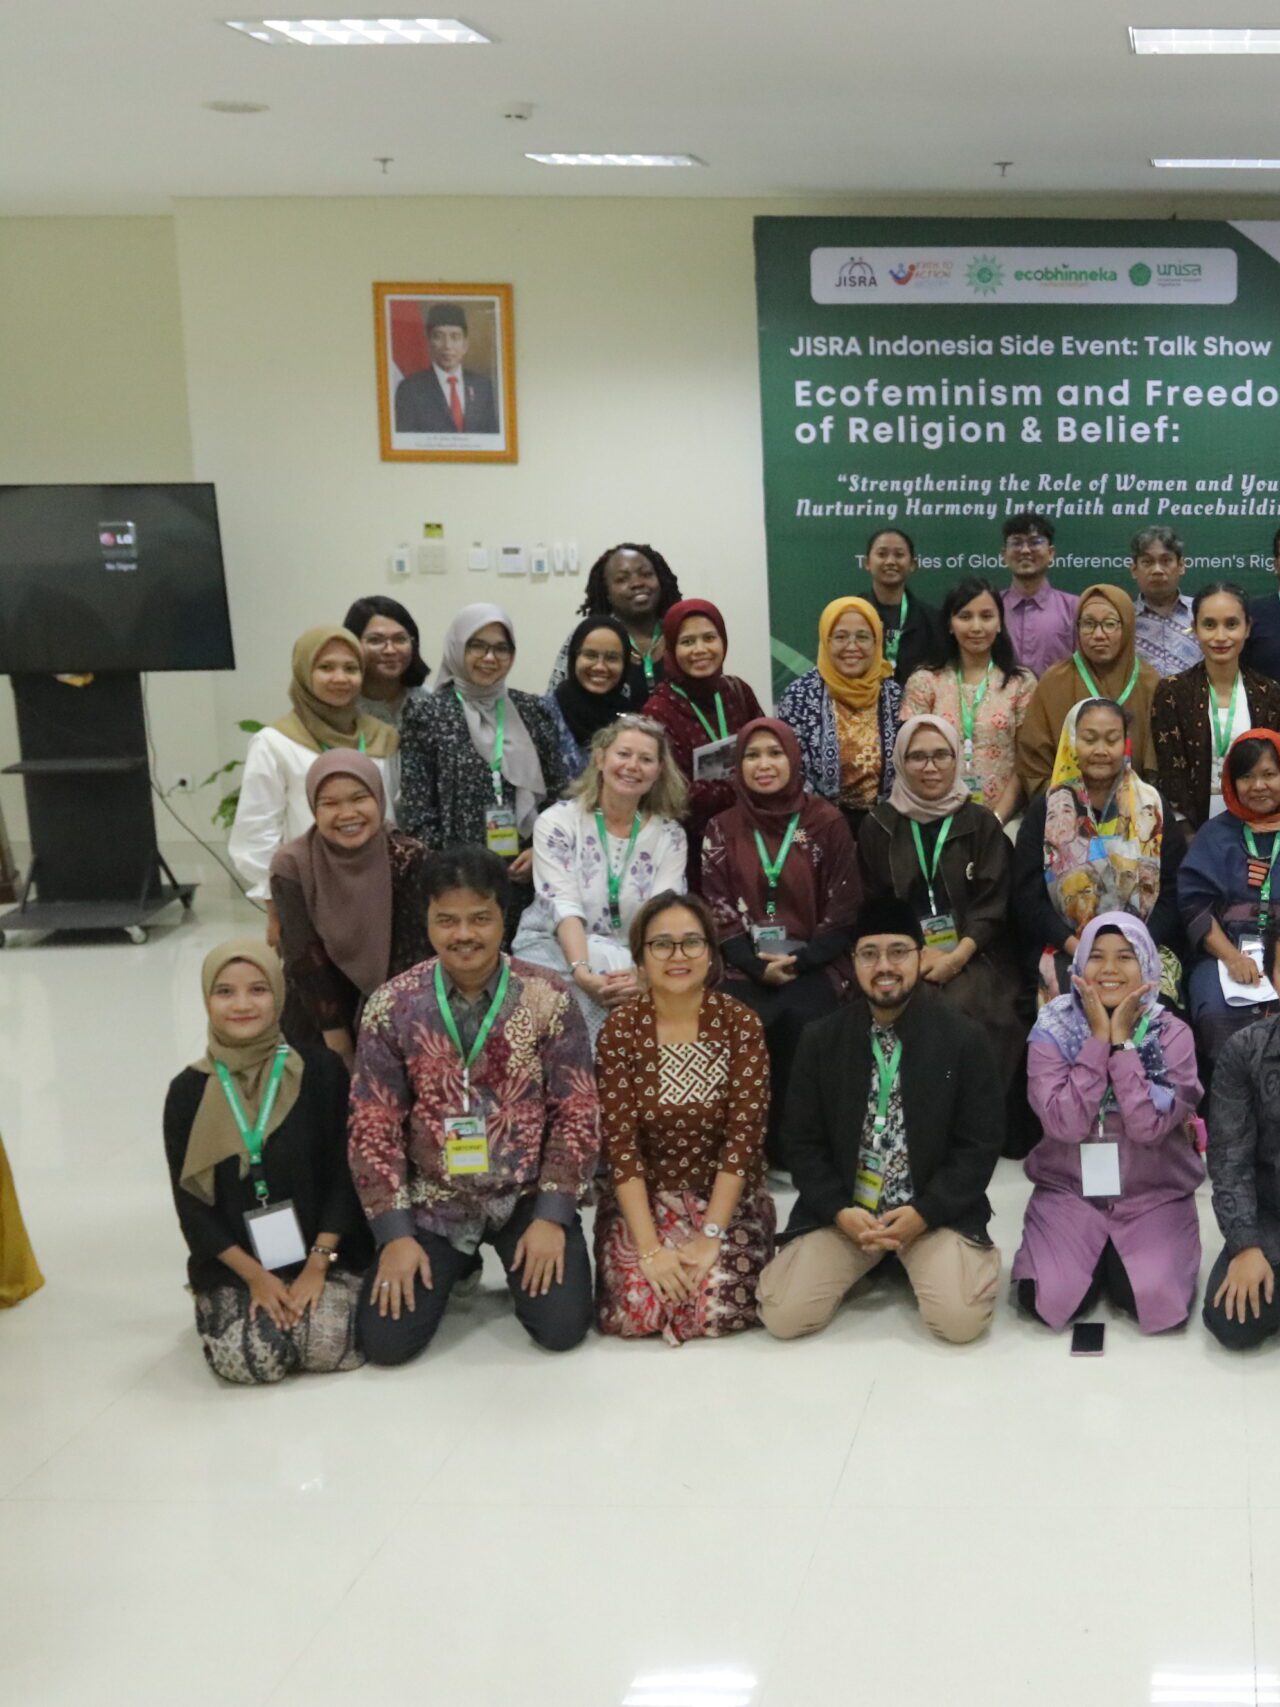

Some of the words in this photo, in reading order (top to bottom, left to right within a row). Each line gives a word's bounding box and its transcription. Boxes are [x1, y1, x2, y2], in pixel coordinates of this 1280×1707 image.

[1014, 265, 1117, 281] ecobhinneka
[1156, 262, 1202, 276] unisa
[835, 276, 877, 287] JISRA
[790, 336, 862, 356] JISRA
[869, 335, 993, 355] Indonesia
[1000, 335, 1054, 355] Side
[1062, 336, 1138, 356] Event:
[1144, 336, 1197, 355] Talk
[1203, 336, 1272, 356] Show
[795, 378, 1042, 407] Ecofeminism
[1057, 379, 1129, 406] and
[795, 415, 834, 444] of
[849, 415, 1006, 450] Religion
[1021, 416, 1042, 443] &
[1057, 415, 1180, 443] Belief:
[838, 474, 991, 496] “Strengthening
[999, 475, 1030, 492] the
[1038, 475, 1081, 492] Role
[1089, 474, 1107, 495] of
[1116, 474, 1187, 491] Women
[1195, 474, 1233, 491] and
[796, 499, 898, 520] Nurturing
[905, 498, 998, 519] Harmony
[1005, 498, 1104, 517] Interfaith
[1112, 499, 1149, 515] and
[946, 553, 965, 569] of
[968, 554, 1009, 569] Glob
[1047, 553, 1135, 569] onference
[1184, 553, 1245, 568] omen's
[1250, 554, 1276, 571] Rig
